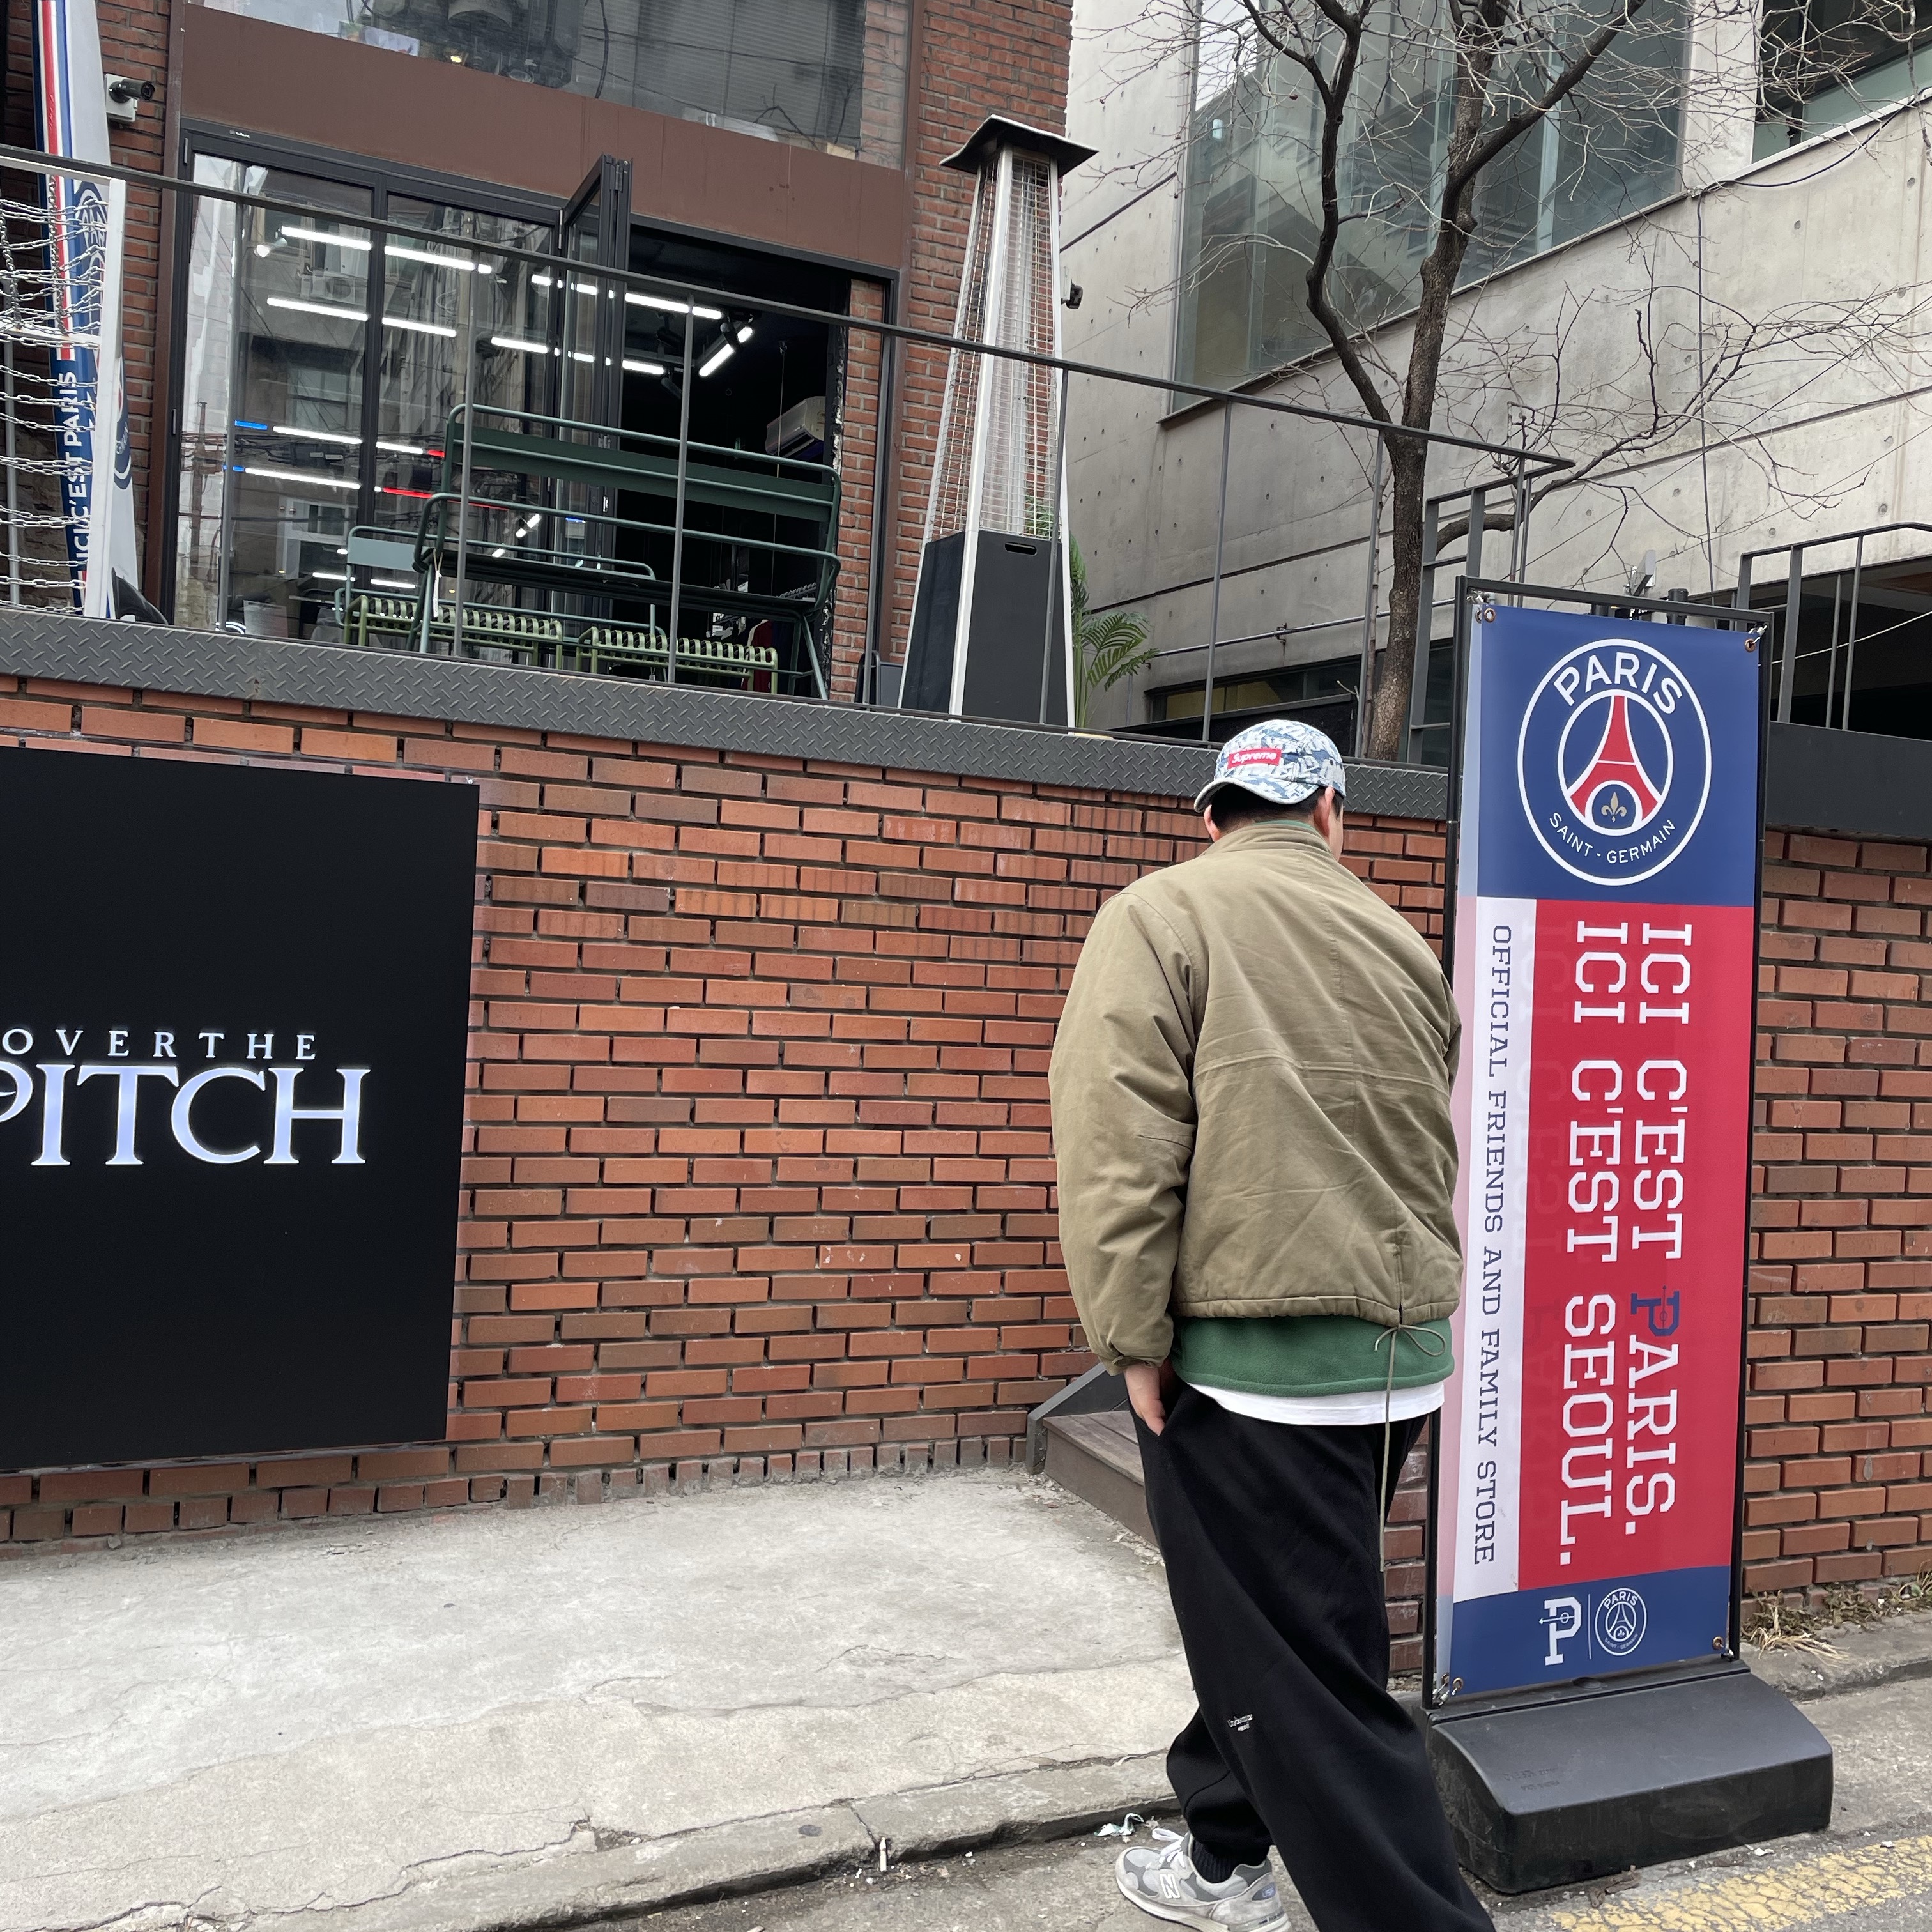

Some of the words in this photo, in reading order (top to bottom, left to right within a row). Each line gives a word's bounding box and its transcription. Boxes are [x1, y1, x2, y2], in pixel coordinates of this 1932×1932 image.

[59, 371, 83, 447] PARIS
[1553, 652, 1683, 714] PARIS
[1231, 751, 1277, 763] Supreme
[1549, 812, 1593, 857] SAINT
[1606, 819, 1676, 864] GERMAIN
[1489, 926, 1512, 1077] OFFICIAL
[1574, 921, 1629, 1023] ICI
[1639, 923, 1692, 1024] ICI
[1485, 1090, 1507, 1233] FRIENDS
[1567, 1059, 1624, 1262] C'EST
[1632, 1059, 1688, 1259] C'EST
[1482, 1246, 1502, 1315] AND
[1478, 1328, 1500, 1447] FAMILY
[1560, 1294, 1616, 1565] SEOUL.
[1625, 1291, 1680, 1535] PARIS.
[1474, 1460, 1496, 1565] STORE
[1603, 1591, 1638, 1609] PARIS
[1160, 1873, 1181, 1899] N
